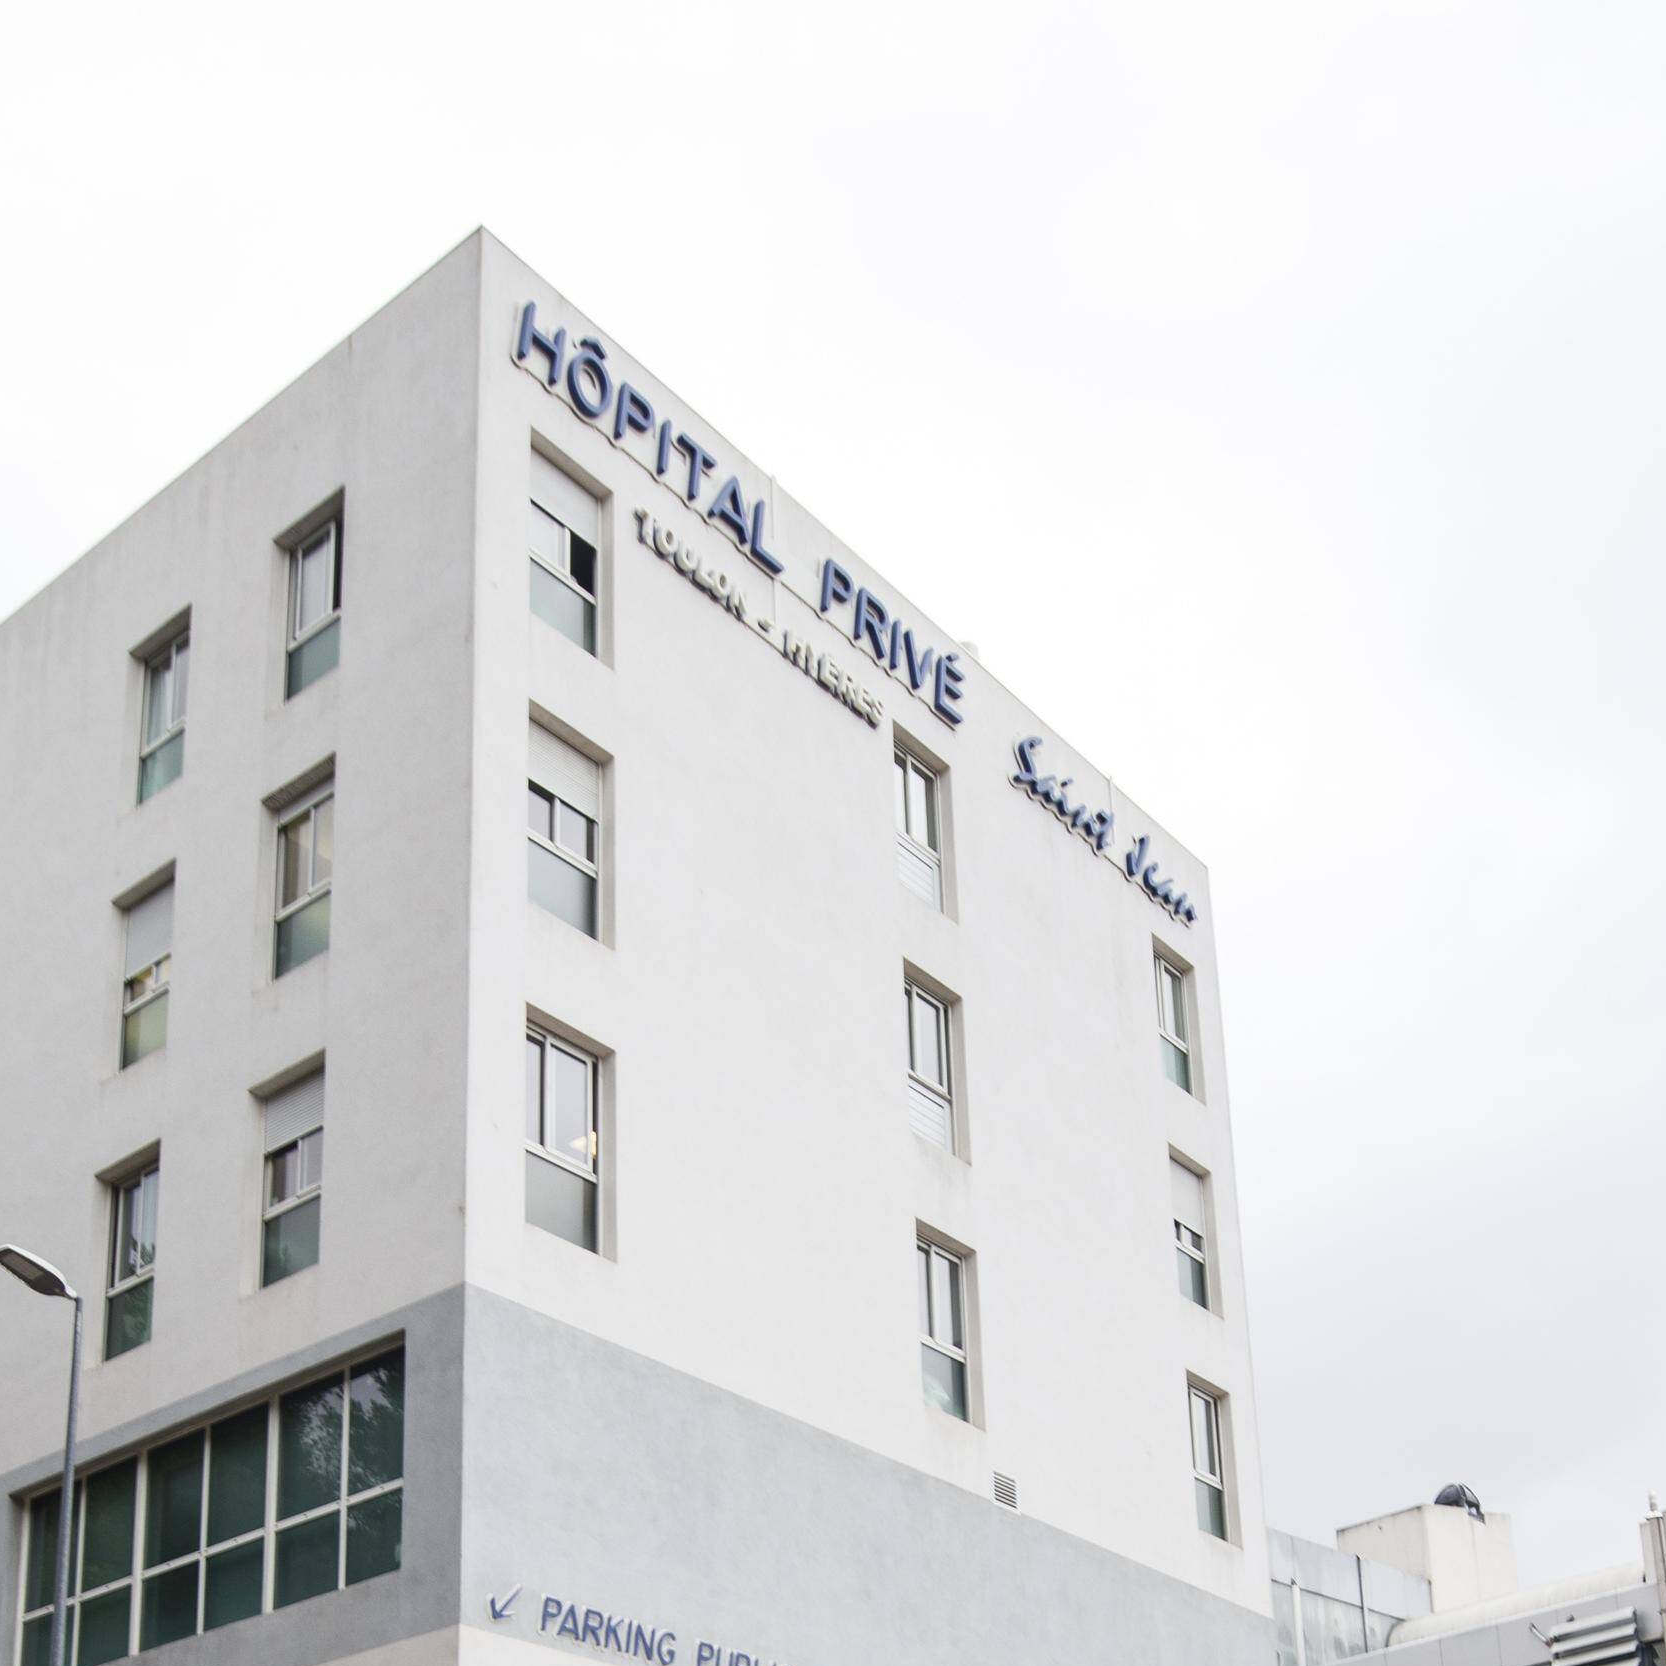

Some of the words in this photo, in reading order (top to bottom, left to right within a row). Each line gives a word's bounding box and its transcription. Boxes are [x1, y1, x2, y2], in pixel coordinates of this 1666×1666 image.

[517, 300, 785, 575] HÔPITAL
[820, 558, 965, 725] PRIVÉ
[634, 506, 747, 620] TOULON
[1012, 736, 1115, 851] Saint
[539, 1595, 677, 1666] PARKING
